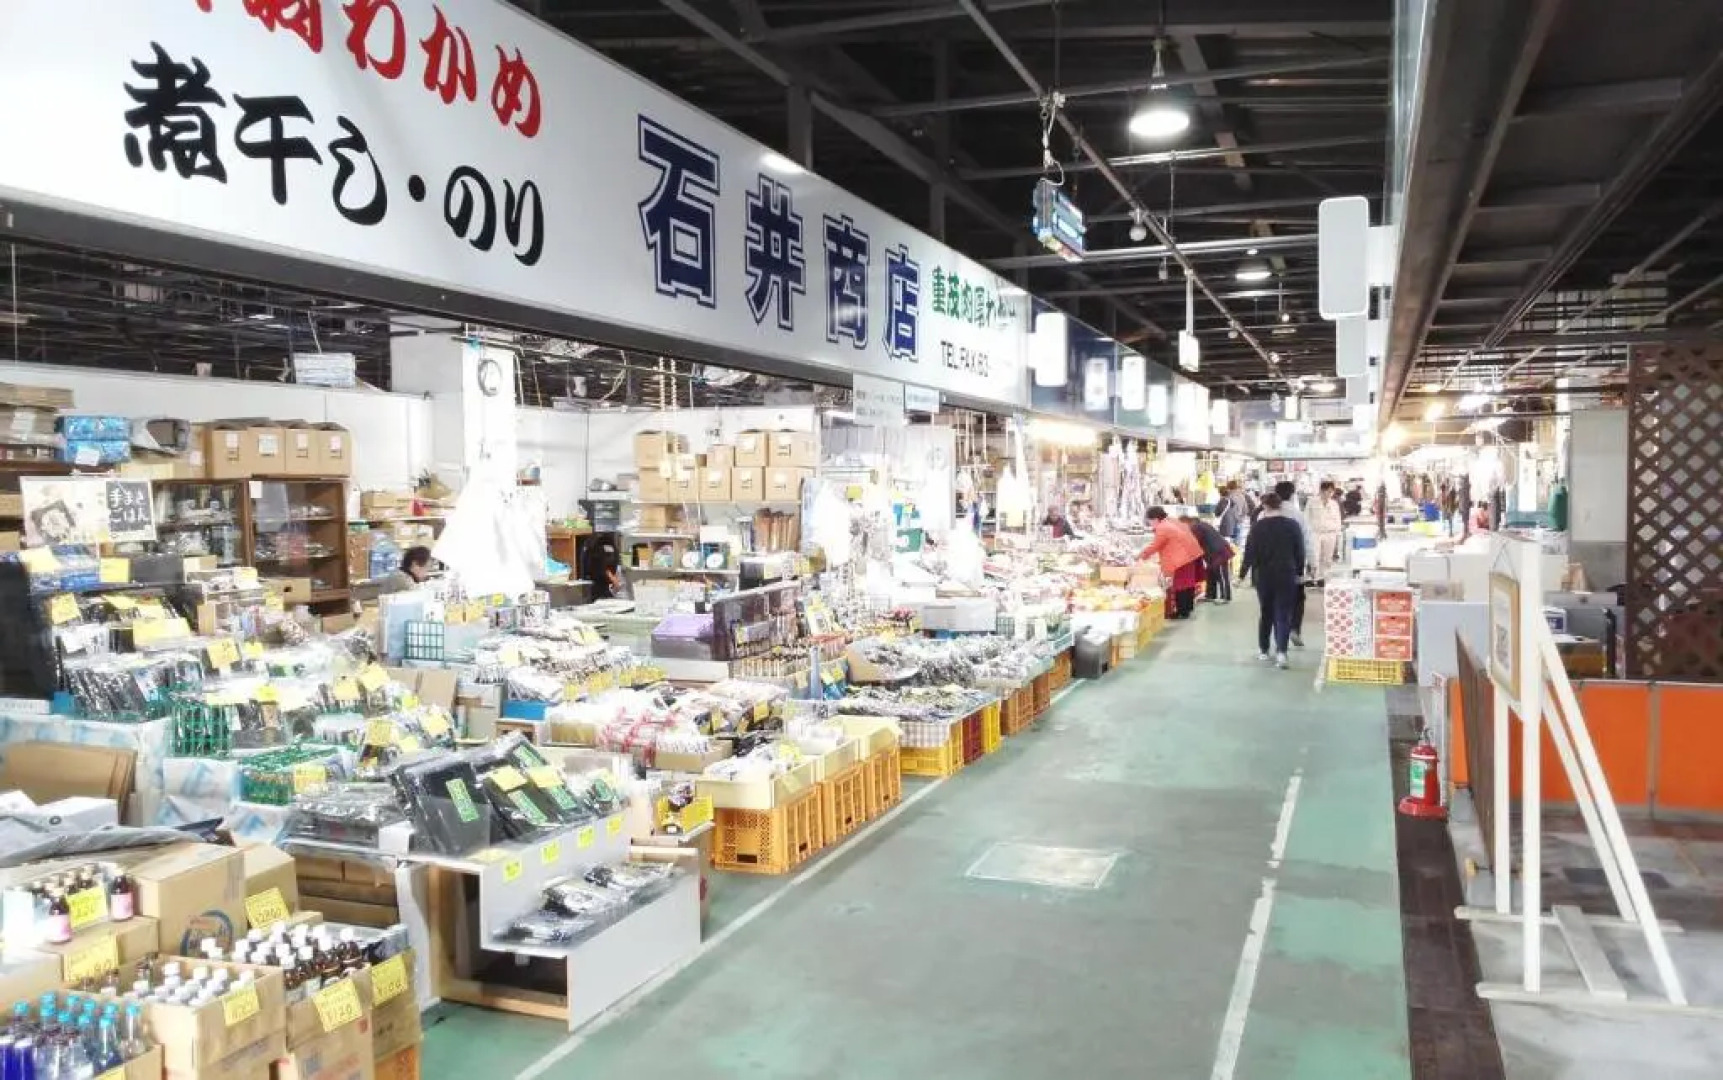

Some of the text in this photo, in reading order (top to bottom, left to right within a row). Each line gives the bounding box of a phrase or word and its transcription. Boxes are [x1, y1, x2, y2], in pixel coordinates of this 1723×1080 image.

[197, 0, 542, 138] わかめ
[637, 113, 922, 362] 石井商店
